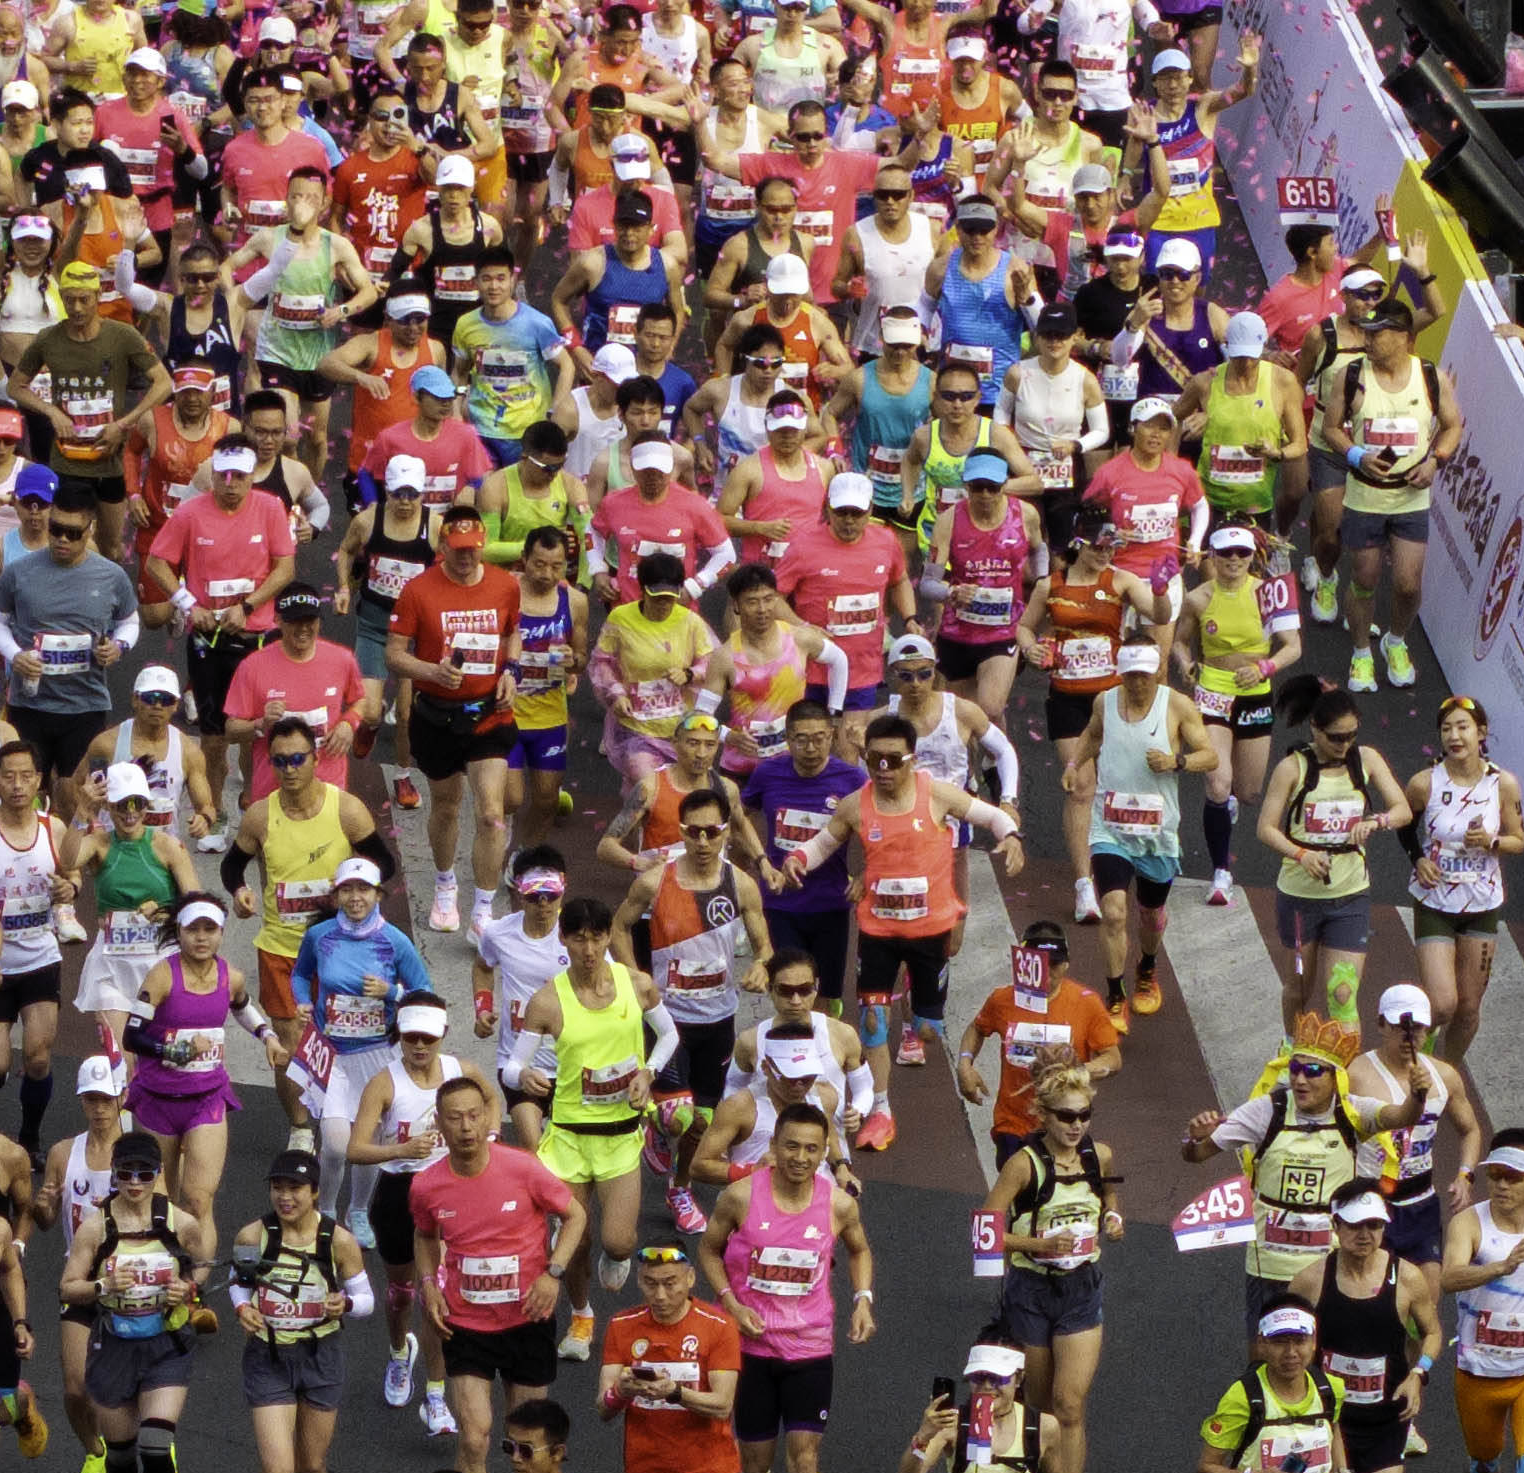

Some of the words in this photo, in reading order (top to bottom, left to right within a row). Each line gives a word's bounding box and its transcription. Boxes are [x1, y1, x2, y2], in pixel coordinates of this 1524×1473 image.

[1287, 182, 1332, 208] 6:15
[278, 643, 322, 661] SPORT
[1321, 816, 1348, 833] 207
[335, 1012, 381, 1028] 20836
[1286, 1170, 1320, 1186] NB
[1180, 1181, 1246, 1222] 3:45
[1286, 1187, 1318, 1204] RC
[274, 1301, 303, 1316] 201
